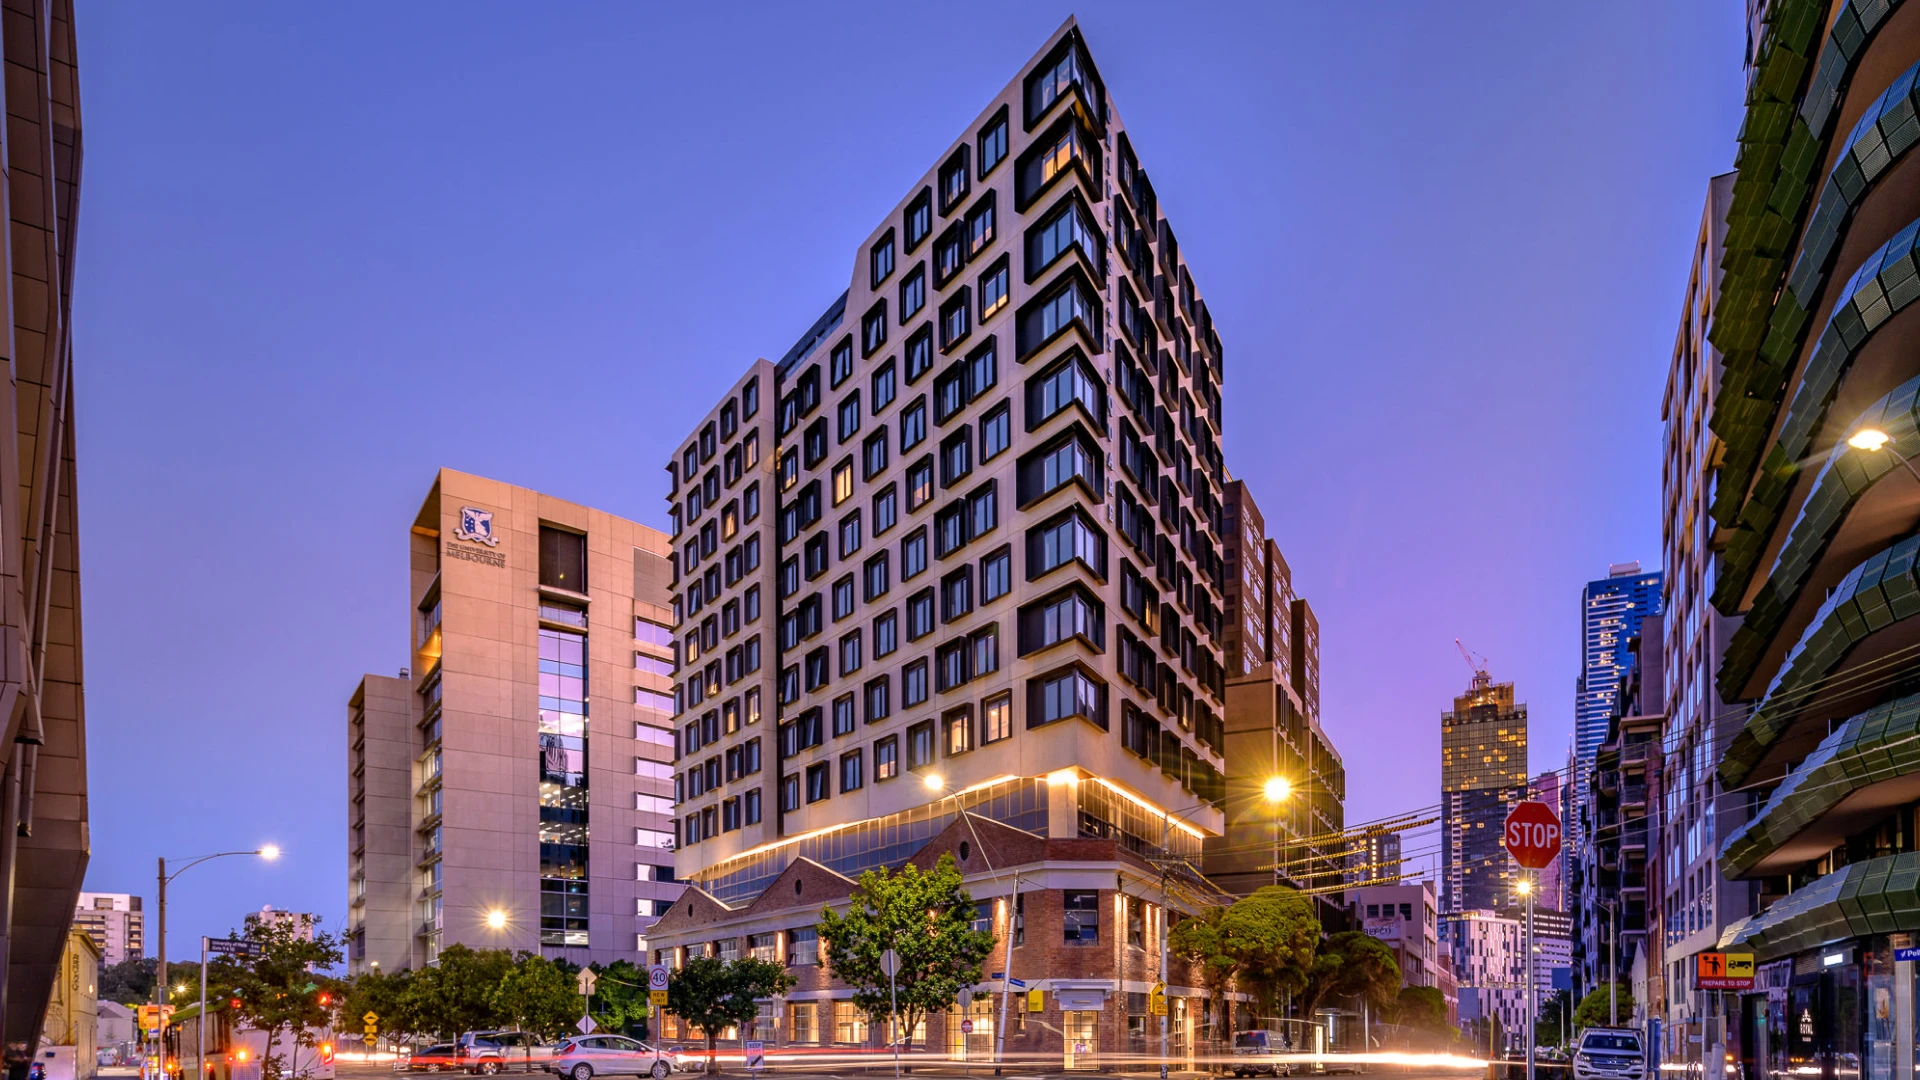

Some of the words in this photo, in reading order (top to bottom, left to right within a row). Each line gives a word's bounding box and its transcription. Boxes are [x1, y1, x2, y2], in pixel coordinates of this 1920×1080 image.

[1106, 367, 1114, 523] SQUARE
[446, 541, 458, 549] THE
[459, 545, 495, 556] UNIVERSITY
[446, 550, 505, 568] MELBOURNE
[1508, 821, 1559, 849] STOP
[652, 973, 665, 982] 40
